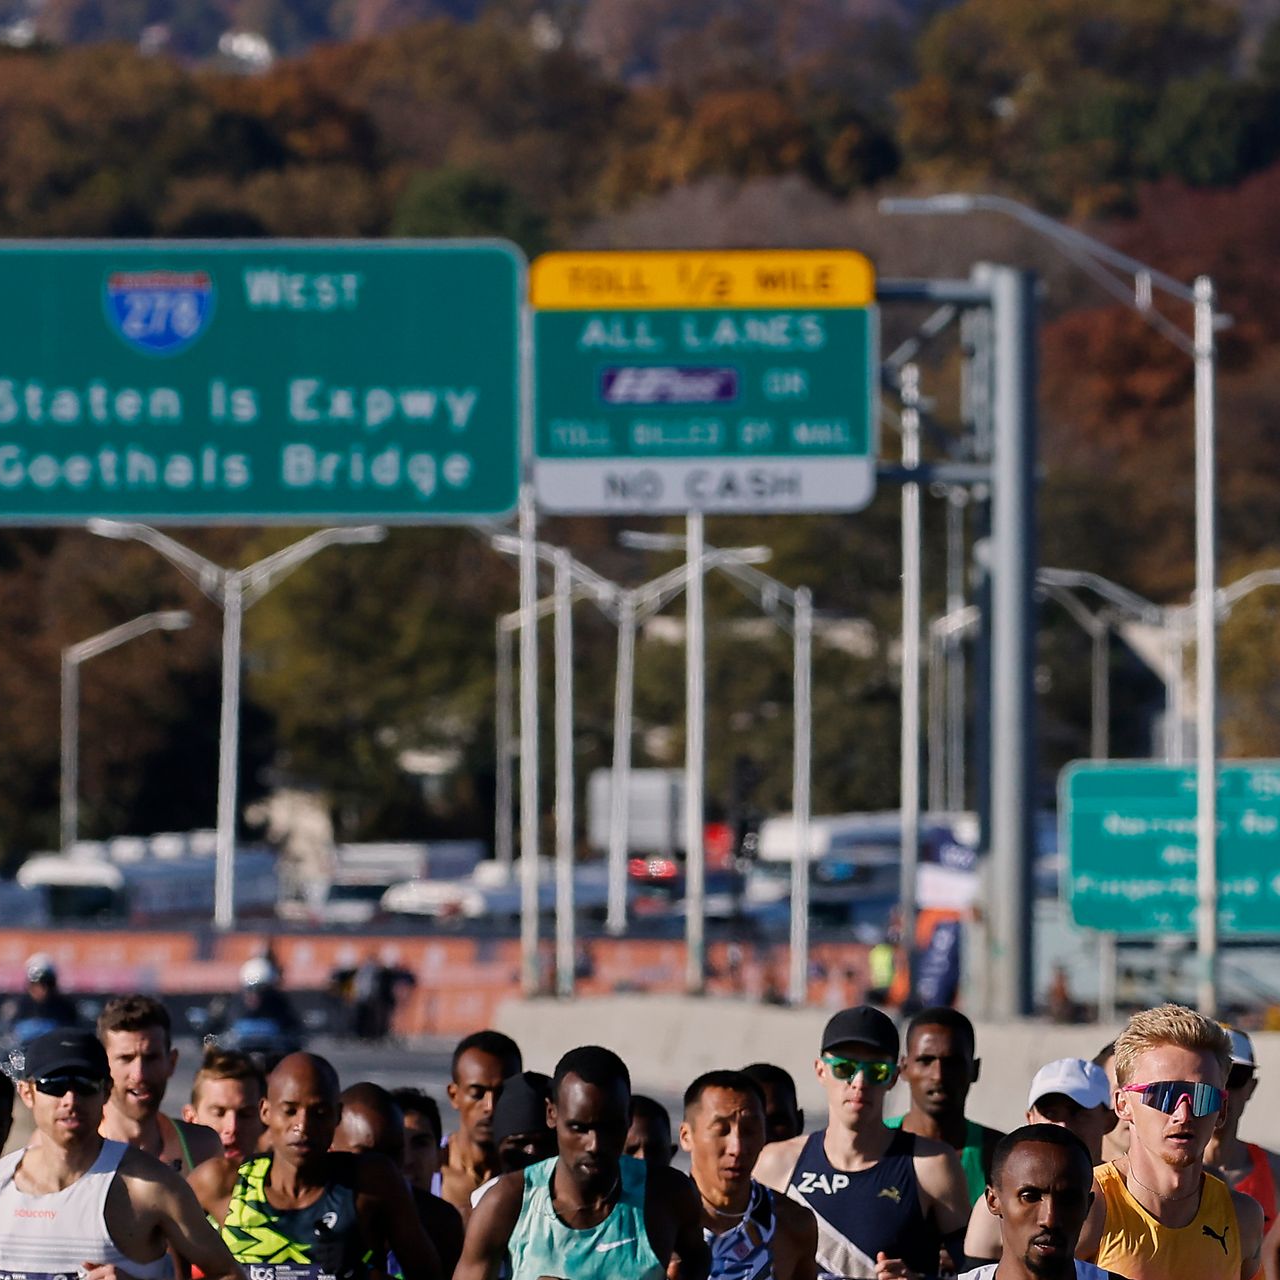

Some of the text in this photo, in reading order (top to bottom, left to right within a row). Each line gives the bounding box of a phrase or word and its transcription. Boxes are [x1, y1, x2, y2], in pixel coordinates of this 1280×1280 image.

[242, 267, 360, 309] WEST
[756, 264, 835, 293] MILE
[580, 315, 826, 347] ALL LANES
[210, 379, 259, 423] Is
[288, 377, 477, 433] Expwy
[282, 443, 473, 496] Bridge
[604, 468, 803, 499] NO CASH
[797, 1171, 850, 1195] ZAP
[14, 1209, 58, 1219] saucony
[250, 1264, 275, 1280] tcs
